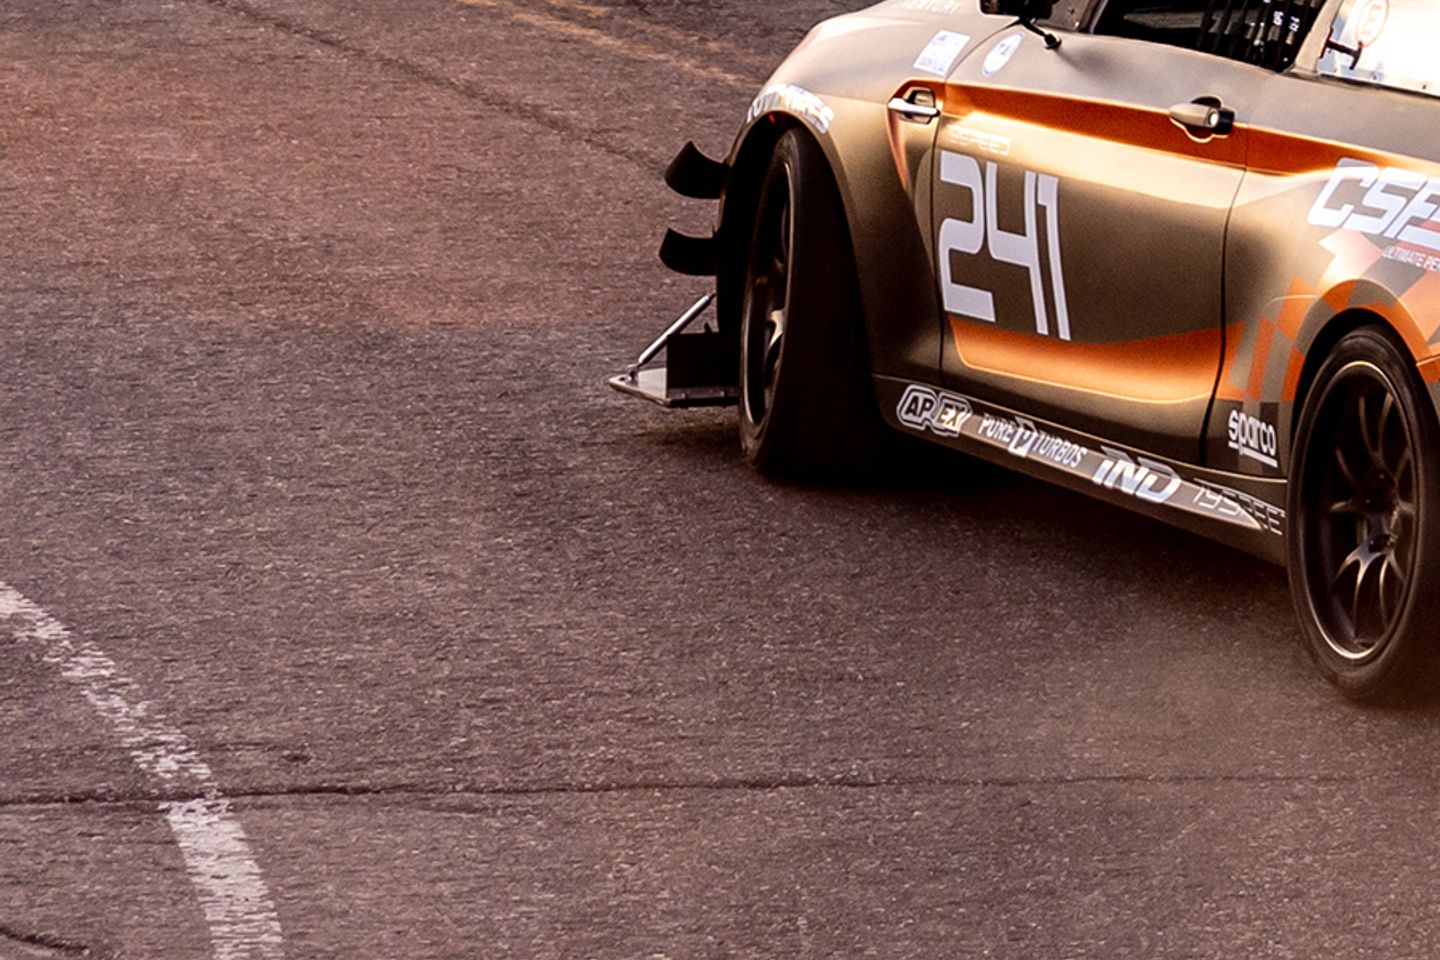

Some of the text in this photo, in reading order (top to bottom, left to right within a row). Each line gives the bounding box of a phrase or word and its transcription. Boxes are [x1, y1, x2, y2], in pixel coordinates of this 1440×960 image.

[938, 149, 1071, 340] 241
[1382, 245, 1427, 268] ULTIMATE
[901, 390, 971, 434] APEX
[1228, 410, 1278, 459] sparco
[978, 412, 1014, 442] PURE
[1032, 431, 1088, 468] TURBOS
